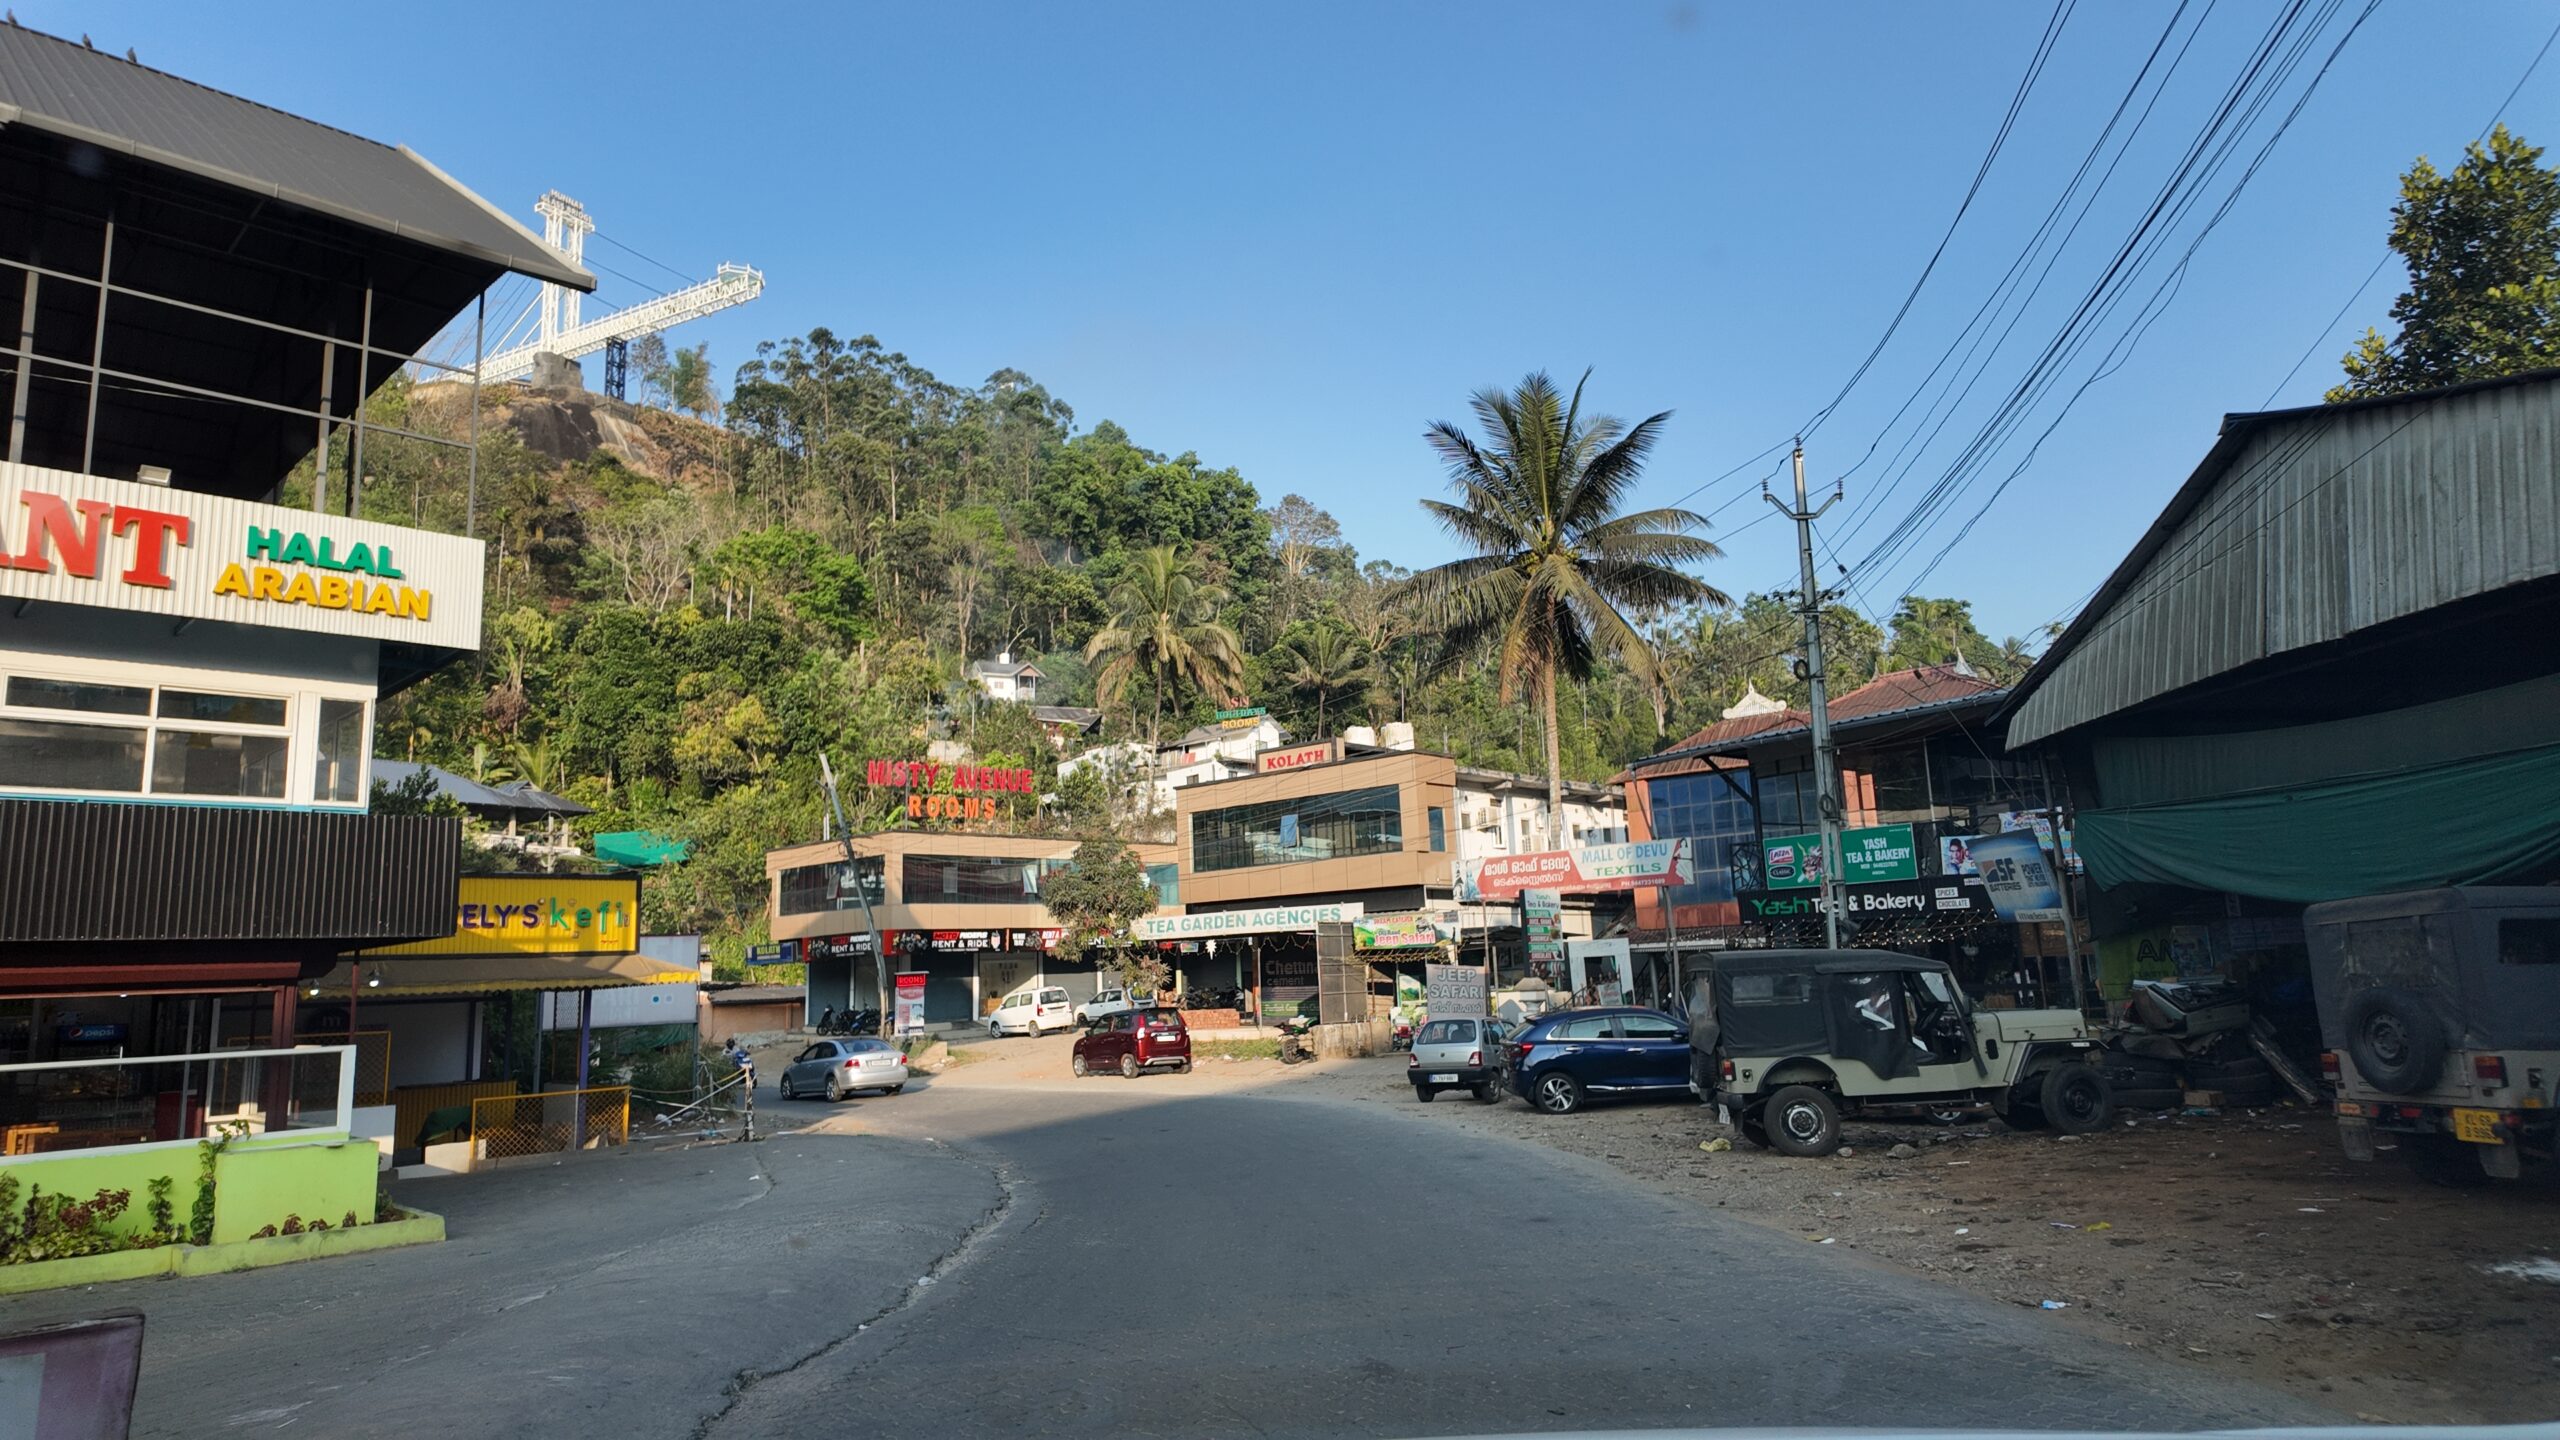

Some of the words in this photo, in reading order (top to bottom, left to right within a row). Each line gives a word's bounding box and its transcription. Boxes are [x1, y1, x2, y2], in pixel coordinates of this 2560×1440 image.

[0, 490, 190, 588] NT
[247, 525, 402, 578] HALAL
[213, 563, 431, 621] ARABIAN
[1221, 716, 1260, 729] ROOMS
[1267, 749, 1325, 770] KOLATH
[867, 759, 940, 788] MISTY
[953, 763, 1034, 793] AVENUE
[907, 795, 996, 820] ROOMS
[1863, 837, 1887, 850] YASH
[1582, 849, 1613, 863] MALL
[1617, 847, 1632, 860] OF
[1635, 844, 1668, 858] DEVU
[1846, 852, 1864, 864] TEA
[1865, 851, 1874, 862] &
[1875, 847, 1911, 861] BAKERY
[1594, 862, 1662, 877] TEXTILS
[1996, 857, 2016, 882] SF
[1752, 896, 1809, 916] Yash
[1848, 895, 1859, 911] &
[1863, 893, 1926, 912] Bakery
[1939, 899, 1969, 908] CHOCOLATE
[458, 902, 540, 929] ELY'S
[550, 897, 624, 935] kefi
[1147, 920, 1176, 934] TEA
[1181, 913, 1247, 933] GARDEN
[1252, 907, 1342, 927] AGENCIES
[931, 940, 957, 949] RENT
[957, 940, 965, 948] &
[966, 939, 989, 948] RIDE
[1401, 931, 1435, 944] Safari
[831, 945, 848, 953] RENT
[899, 975, 925, 985] ROOMS
[1266, 975, 1305, 986] cement
[1438, 967, 1477, 983] JEEP
[1429, 983, 1485, 999] SAFARI
[84, 1028, 115, 1039] pepsi
